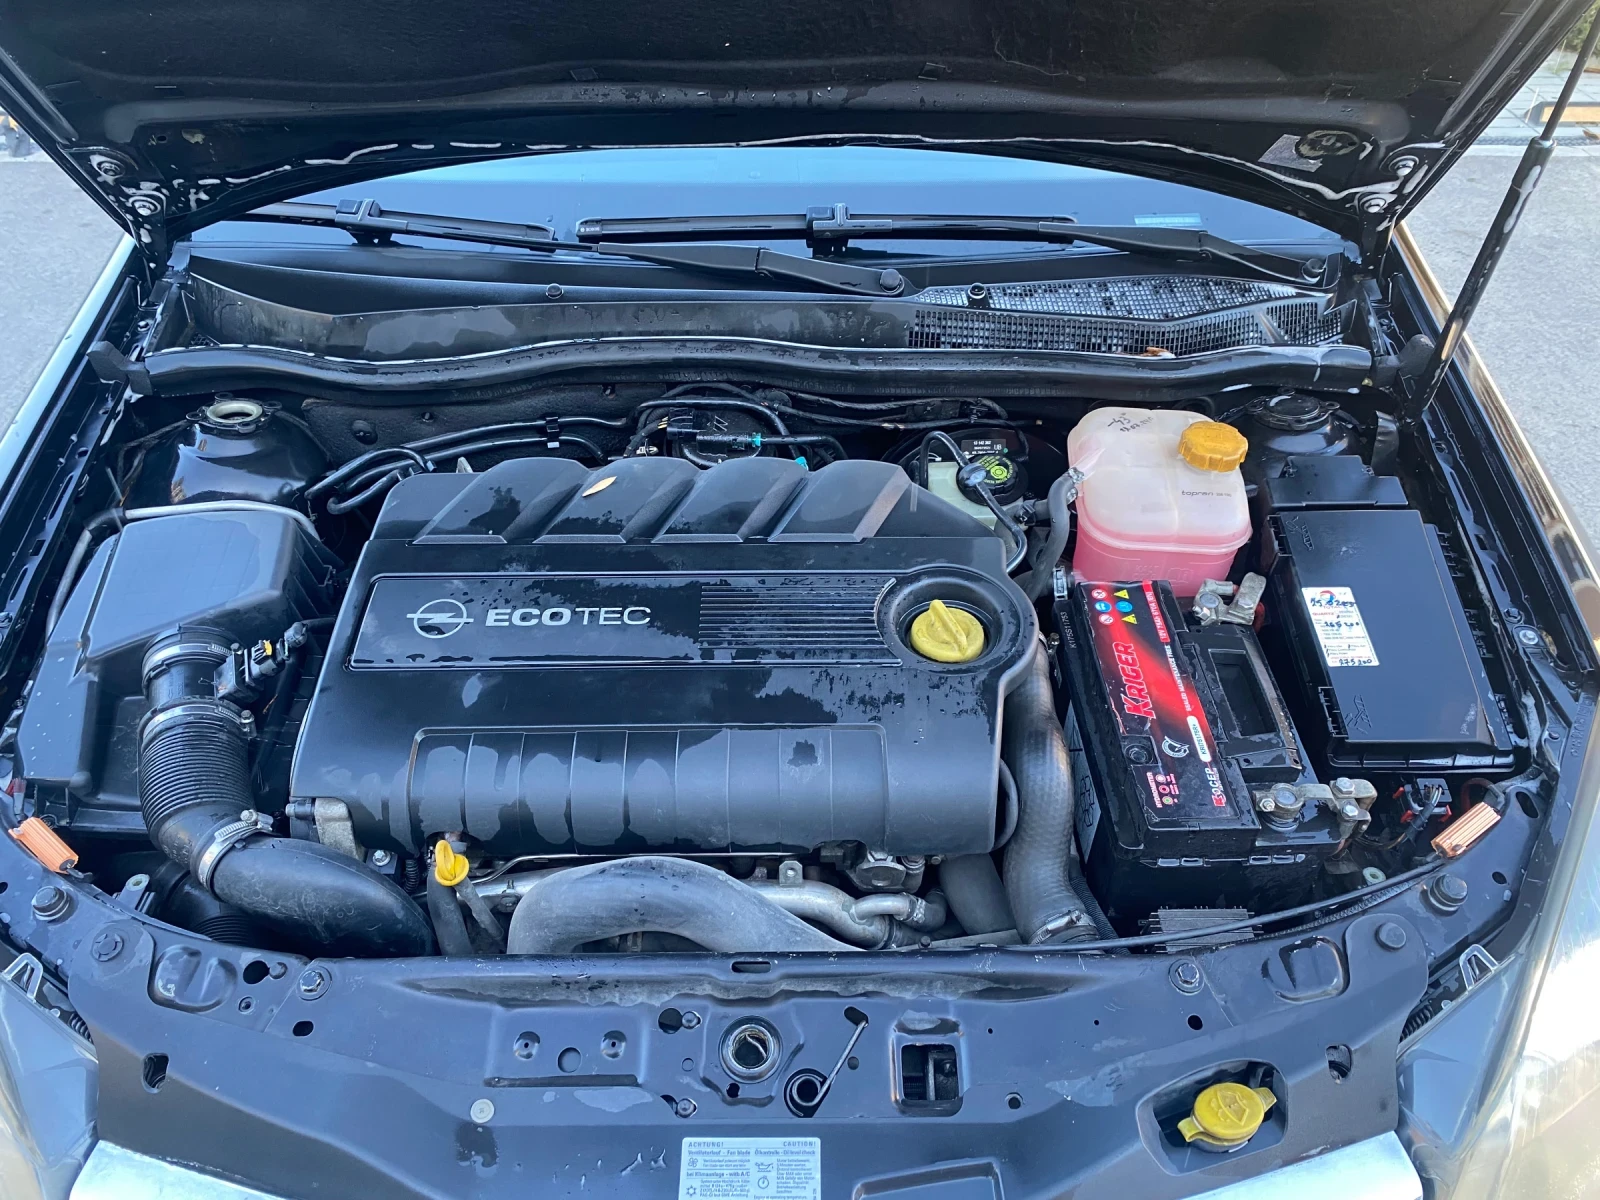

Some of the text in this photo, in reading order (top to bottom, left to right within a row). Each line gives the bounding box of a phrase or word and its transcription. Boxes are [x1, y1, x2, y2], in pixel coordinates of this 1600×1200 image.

[485, 606, 652, 627] ECOTEC
[1112, 642, 1156, 719] KRIGER
[1181, 693, 1192, 711] SEALED
[1146, 772, 1162, 808] HYDROMETER
